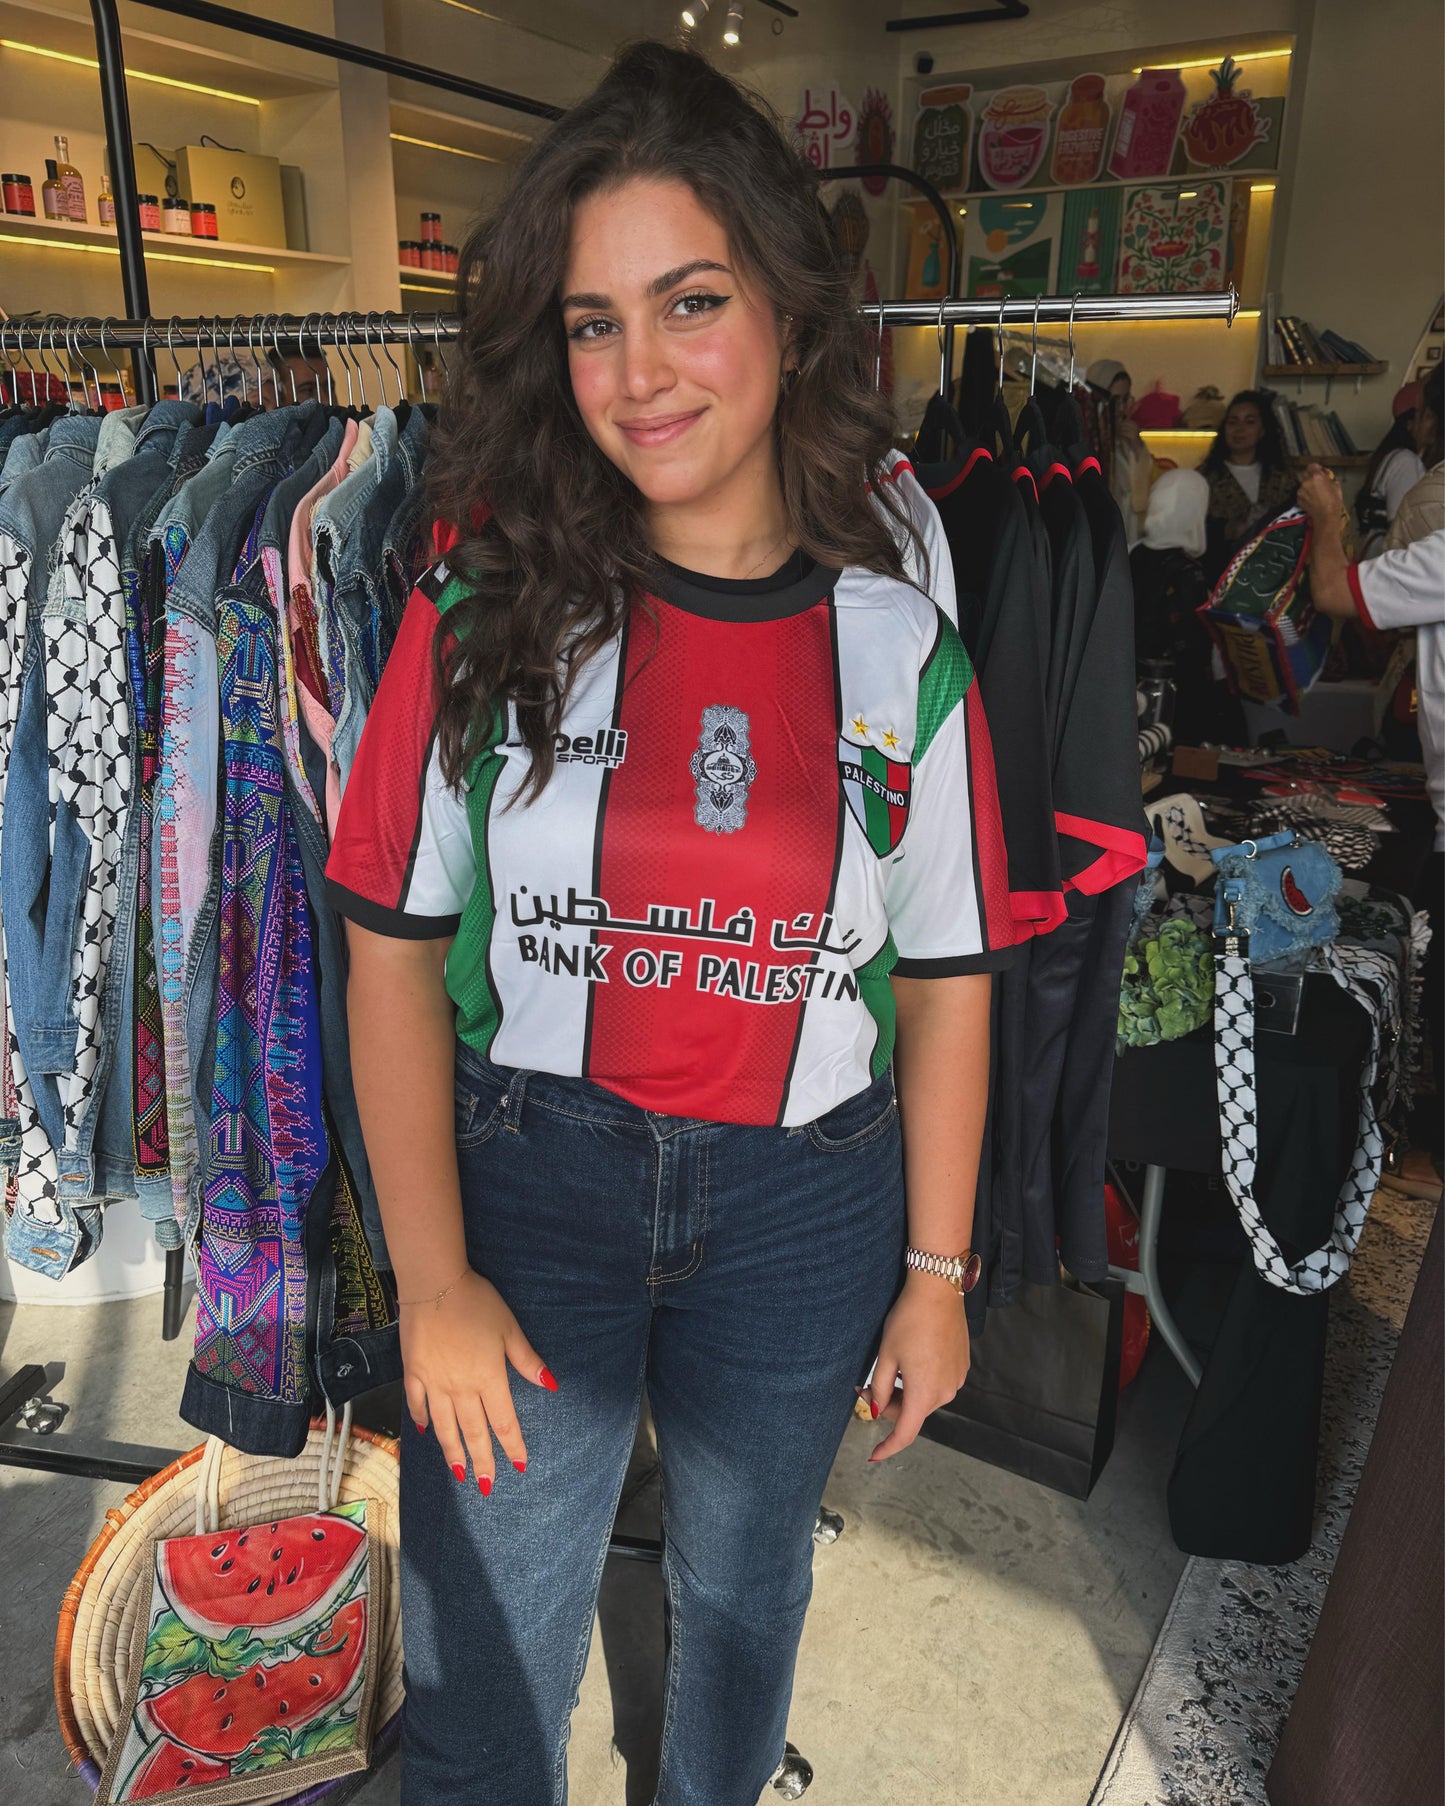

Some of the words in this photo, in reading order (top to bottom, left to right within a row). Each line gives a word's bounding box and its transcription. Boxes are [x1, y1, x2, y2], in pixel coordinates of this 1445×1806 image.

[551, 729, 627, 758] pelli
[556, 753, 623, 767] SPORT
[844, 765, 905, 807] PALESTINO
[511, 885, 754, 944] فلسطين
[518, 934, 613, 981] BANK
[625, 950, 681, 987] OF
[699, 956, 862, 1003] PALESTIN
